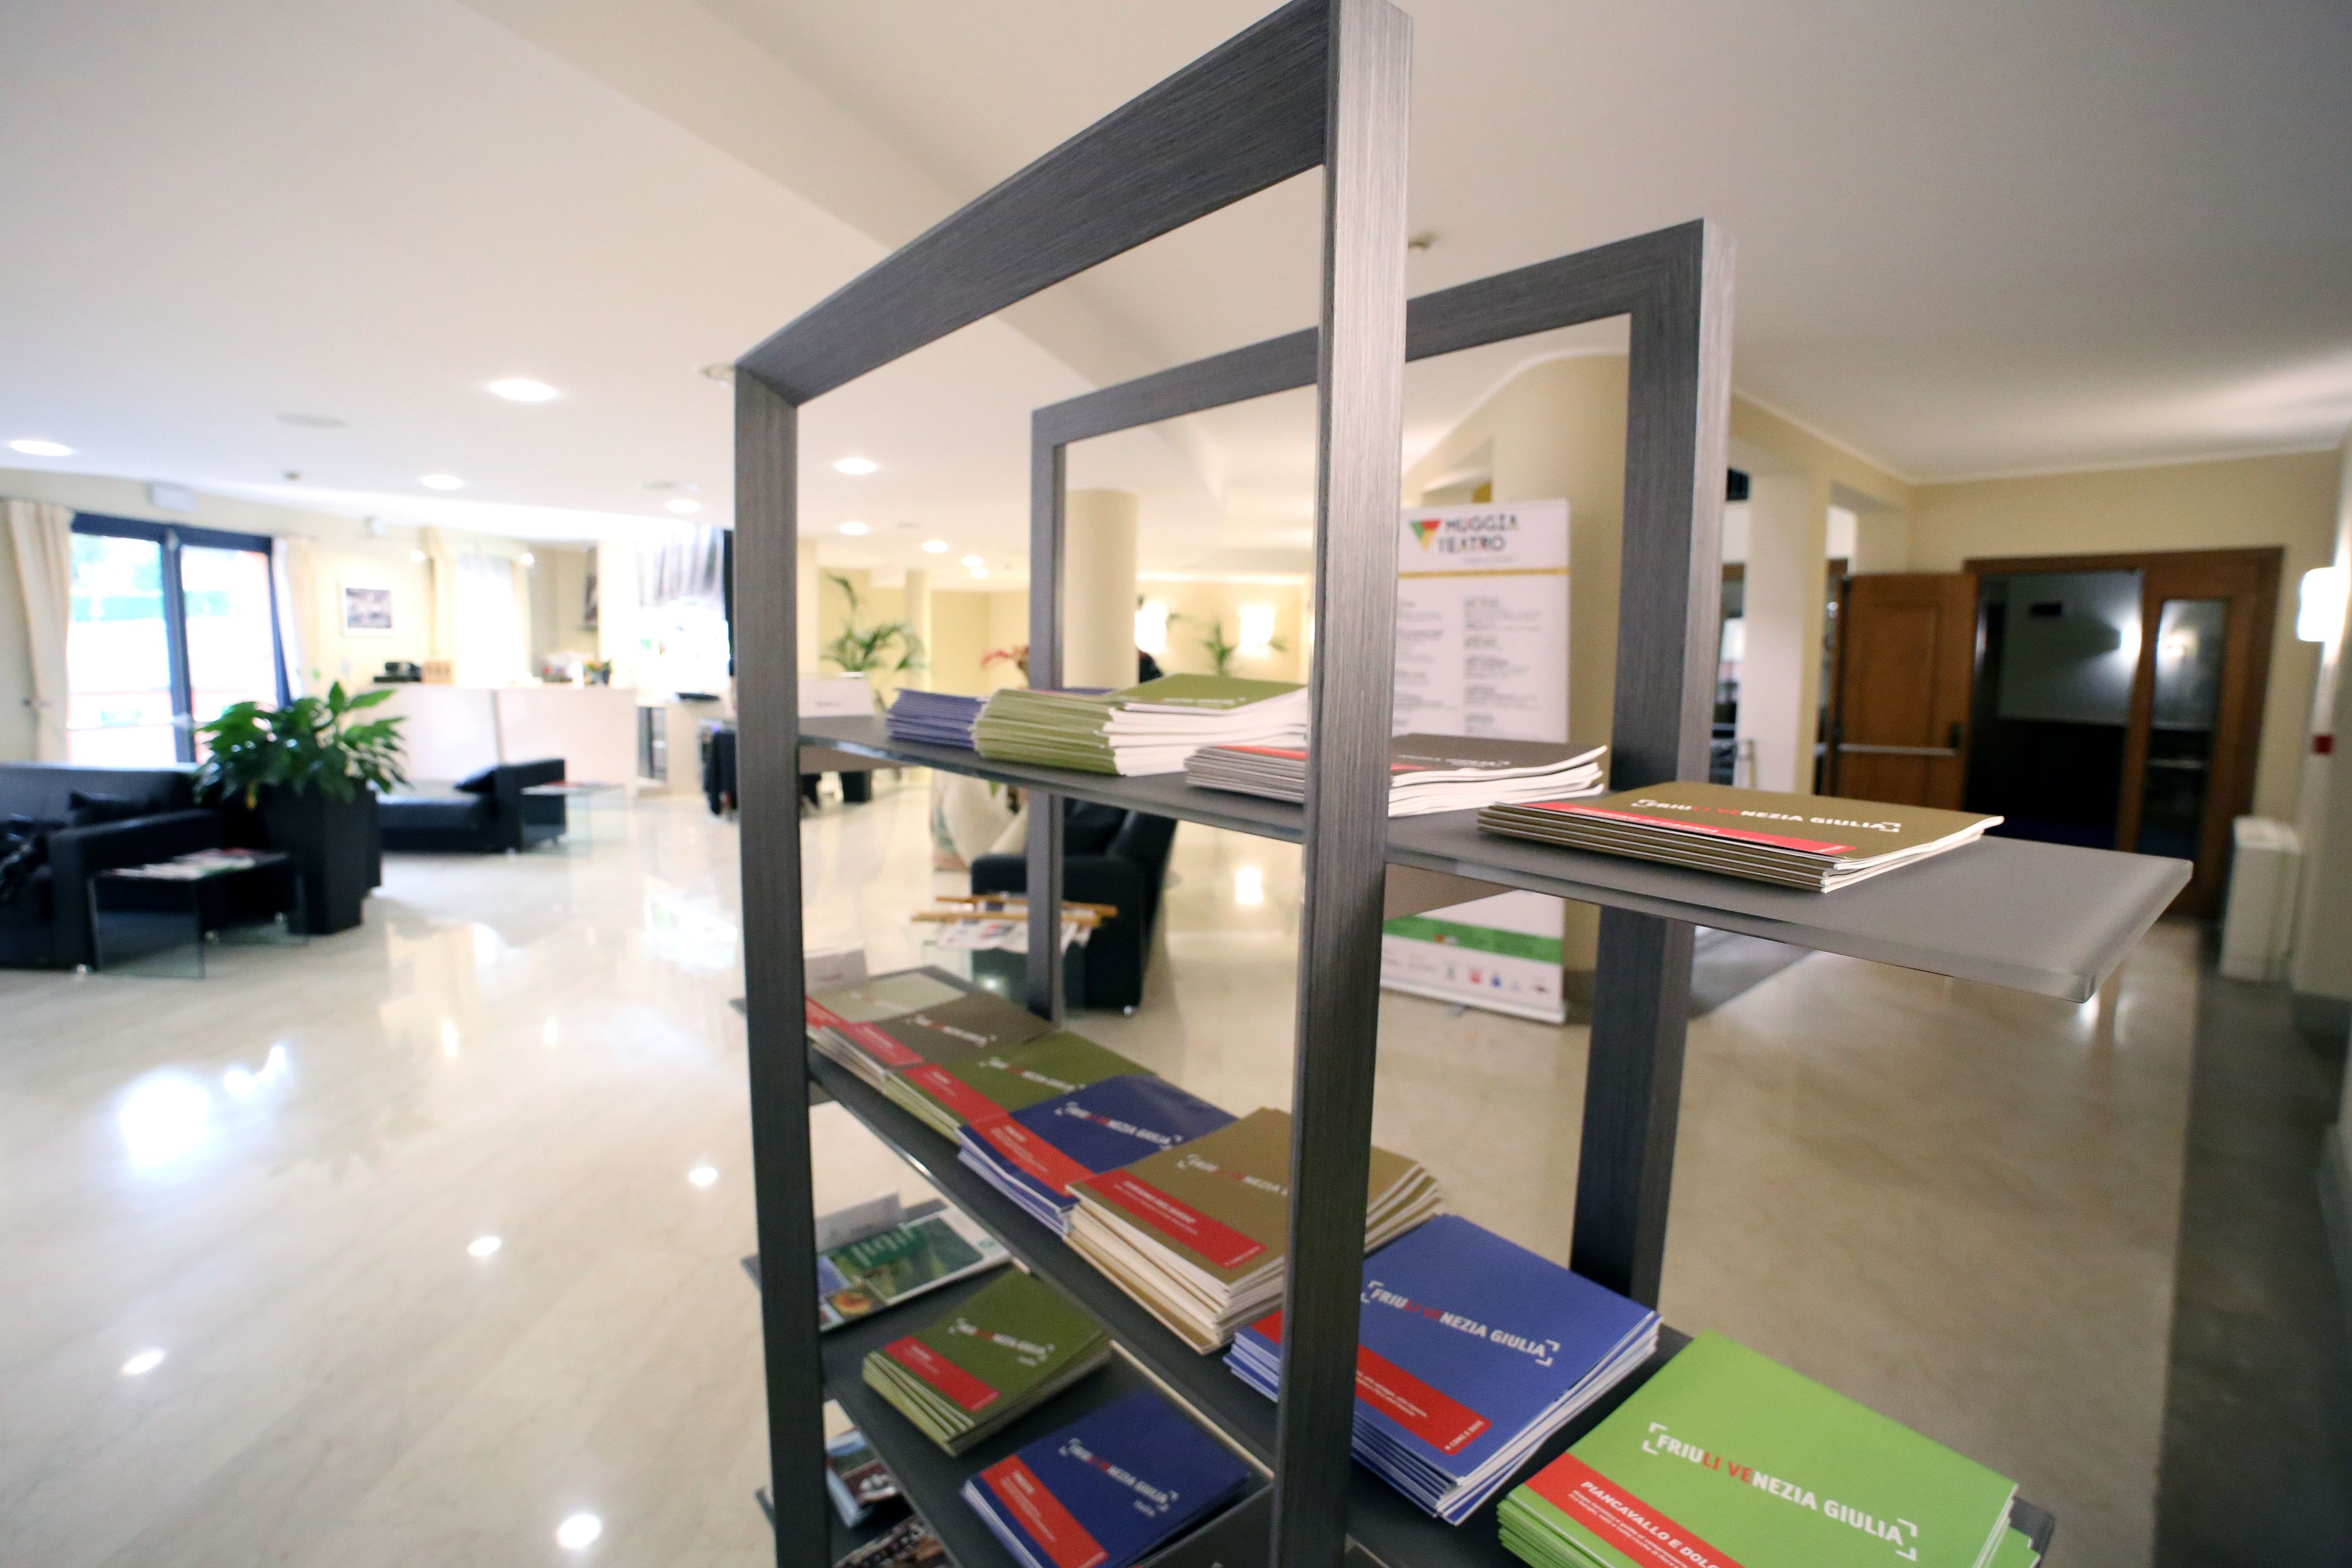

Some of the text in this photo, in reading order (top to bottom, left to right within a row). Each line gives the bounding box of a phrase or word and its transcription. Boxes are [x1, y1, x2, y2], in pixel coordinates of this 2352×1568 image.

[1438, 535, 1507, 553] TEATRO
[1810, 817, 1885, 829] GIULIA
[1371, 1287, 1546, 1358] FRIULI VENEZIA GIULIA
[1580, 1480, 1670, 1541] PIANCAVALLO
[1667, 1537, 1683, 1549] E
[1656, 1433, 1904, 1547] FRIULI VENEZIA GIULIA
